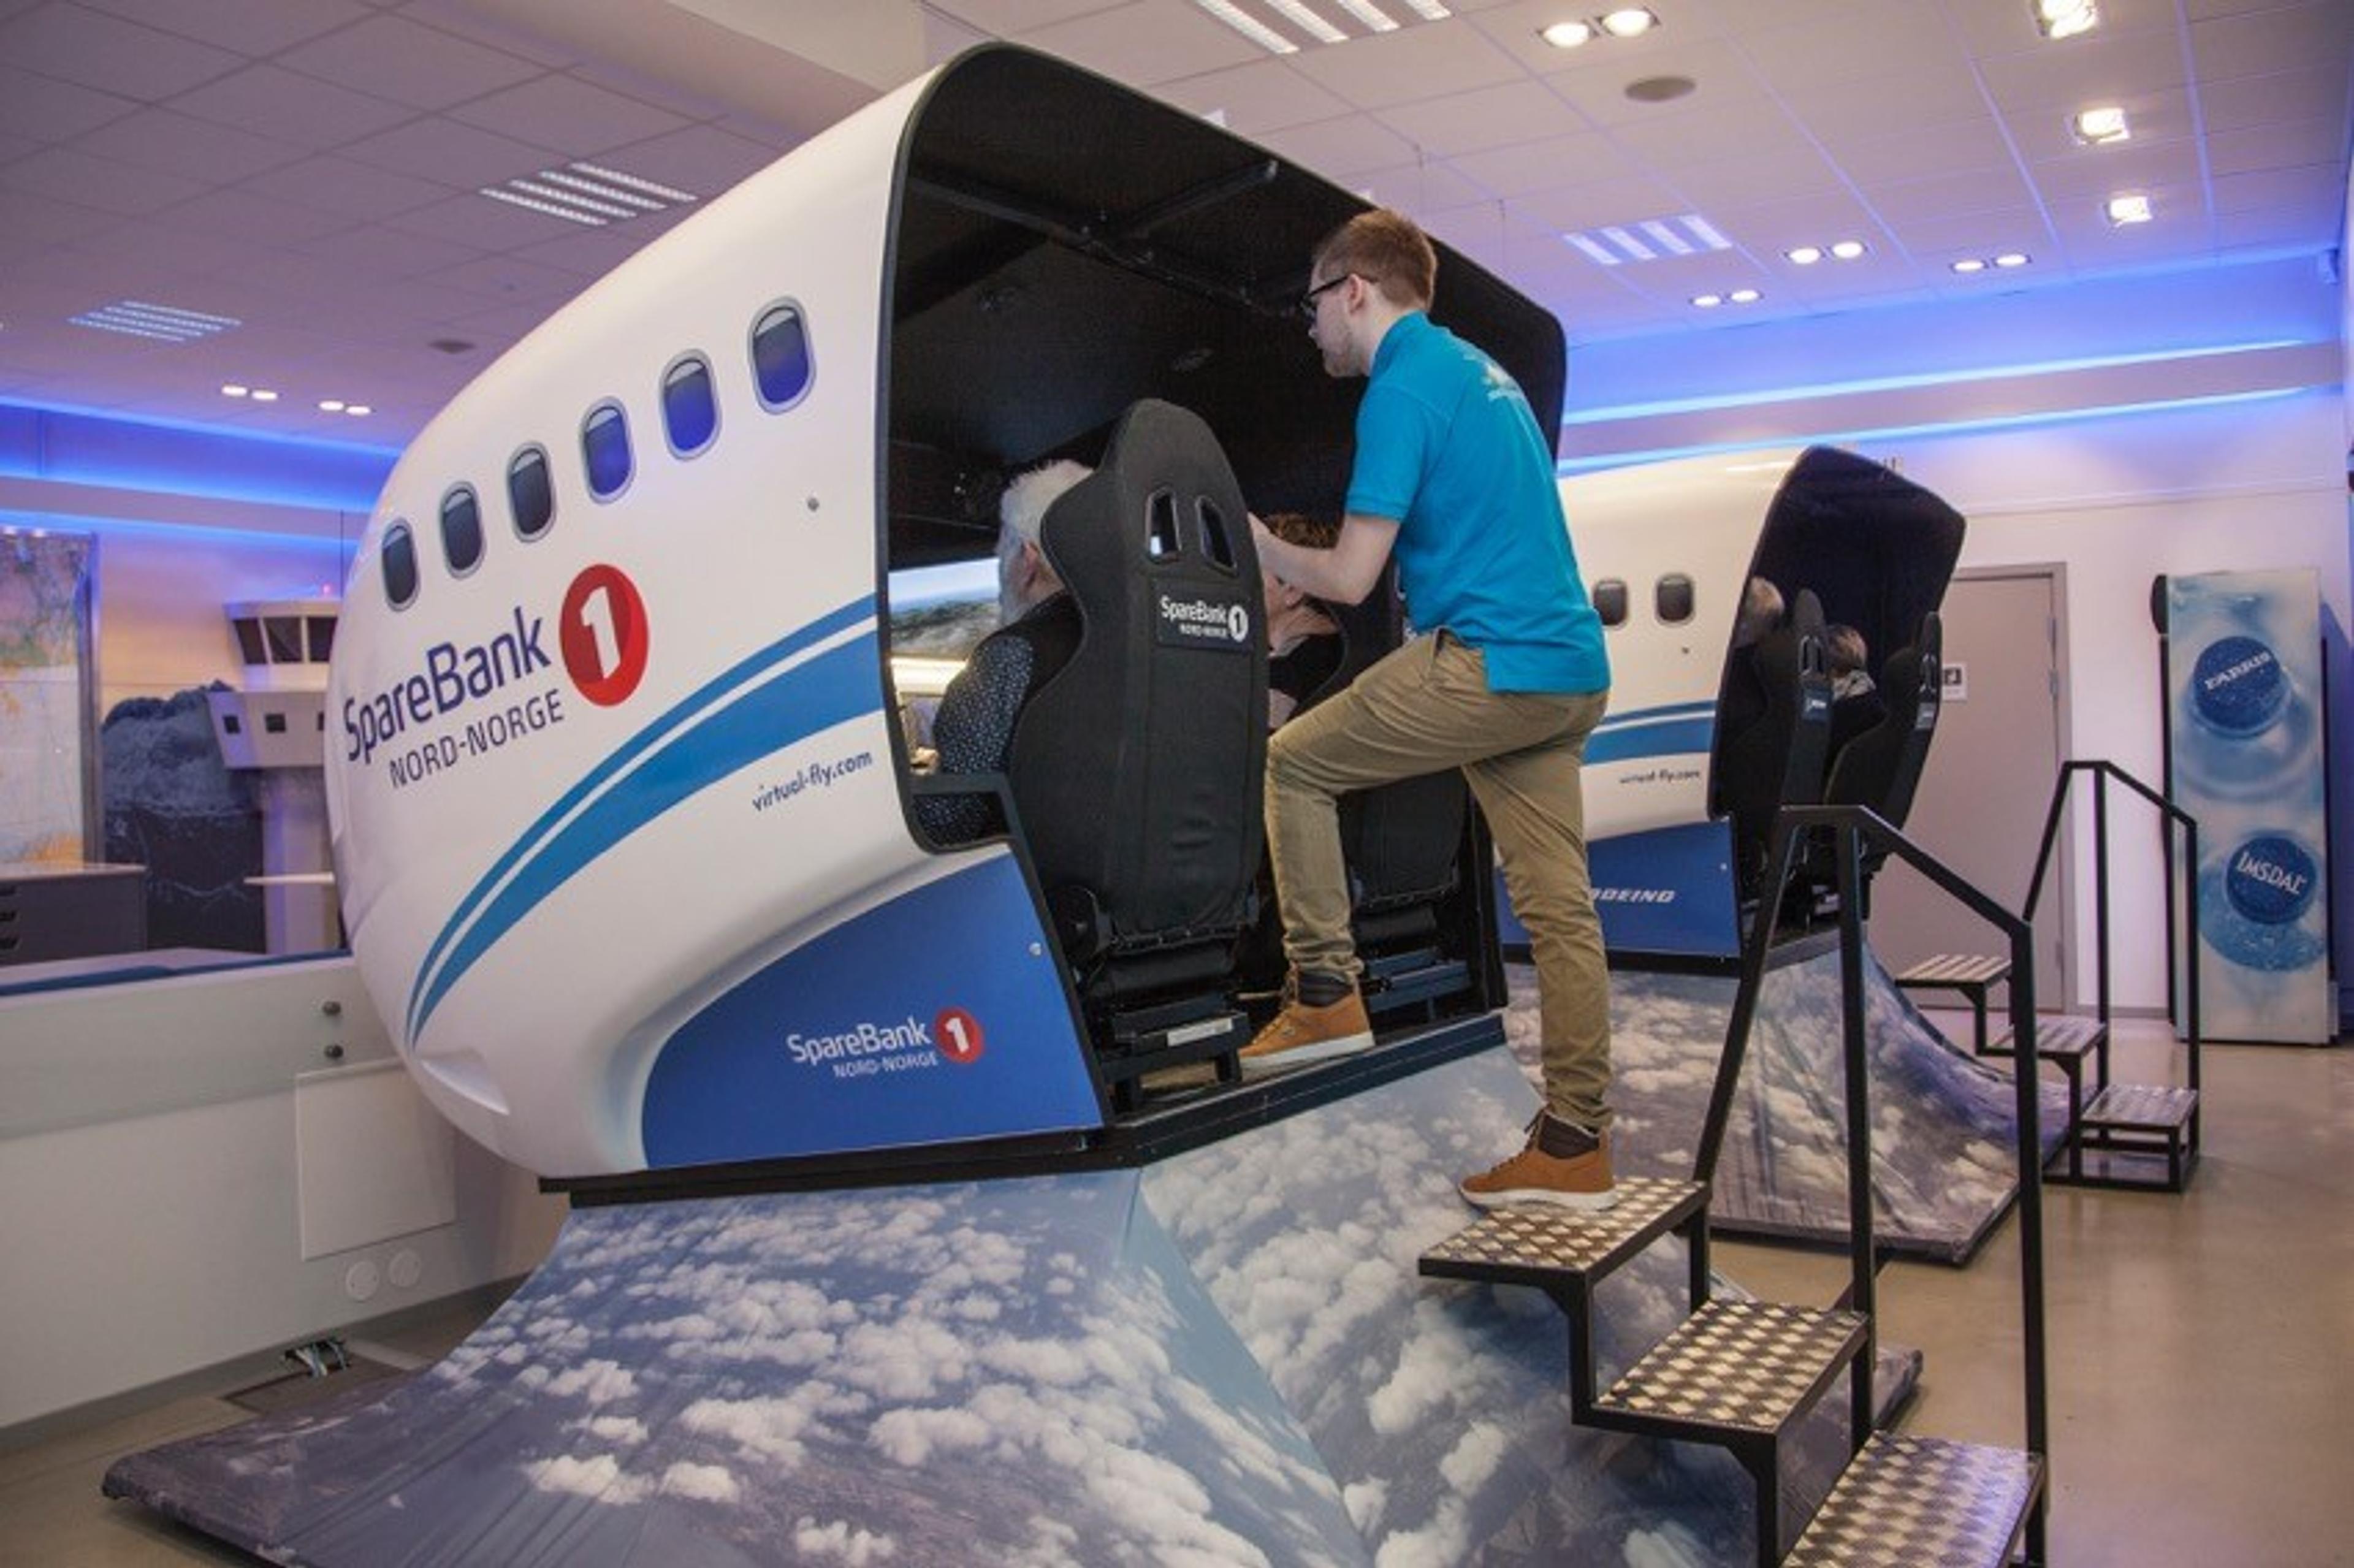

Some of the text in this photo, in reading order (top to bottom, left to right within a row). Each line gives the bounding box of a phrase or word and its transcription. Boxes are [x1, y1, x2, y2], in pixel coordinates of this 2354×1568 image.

[1159, 594, 1227, 622] SpareBank
[344, 586, 622, 764] SpareBank 1
[389, 690, 564, 788] NORD-NORGE
[753, 752, 872, 811] virtual-fly.com
[2236, 851, 2307, 895] IMSDAL
[787, 1016, 969, 1065] SpareBank 1
[832, 1051, 939, 1077] NORD-NORGE
